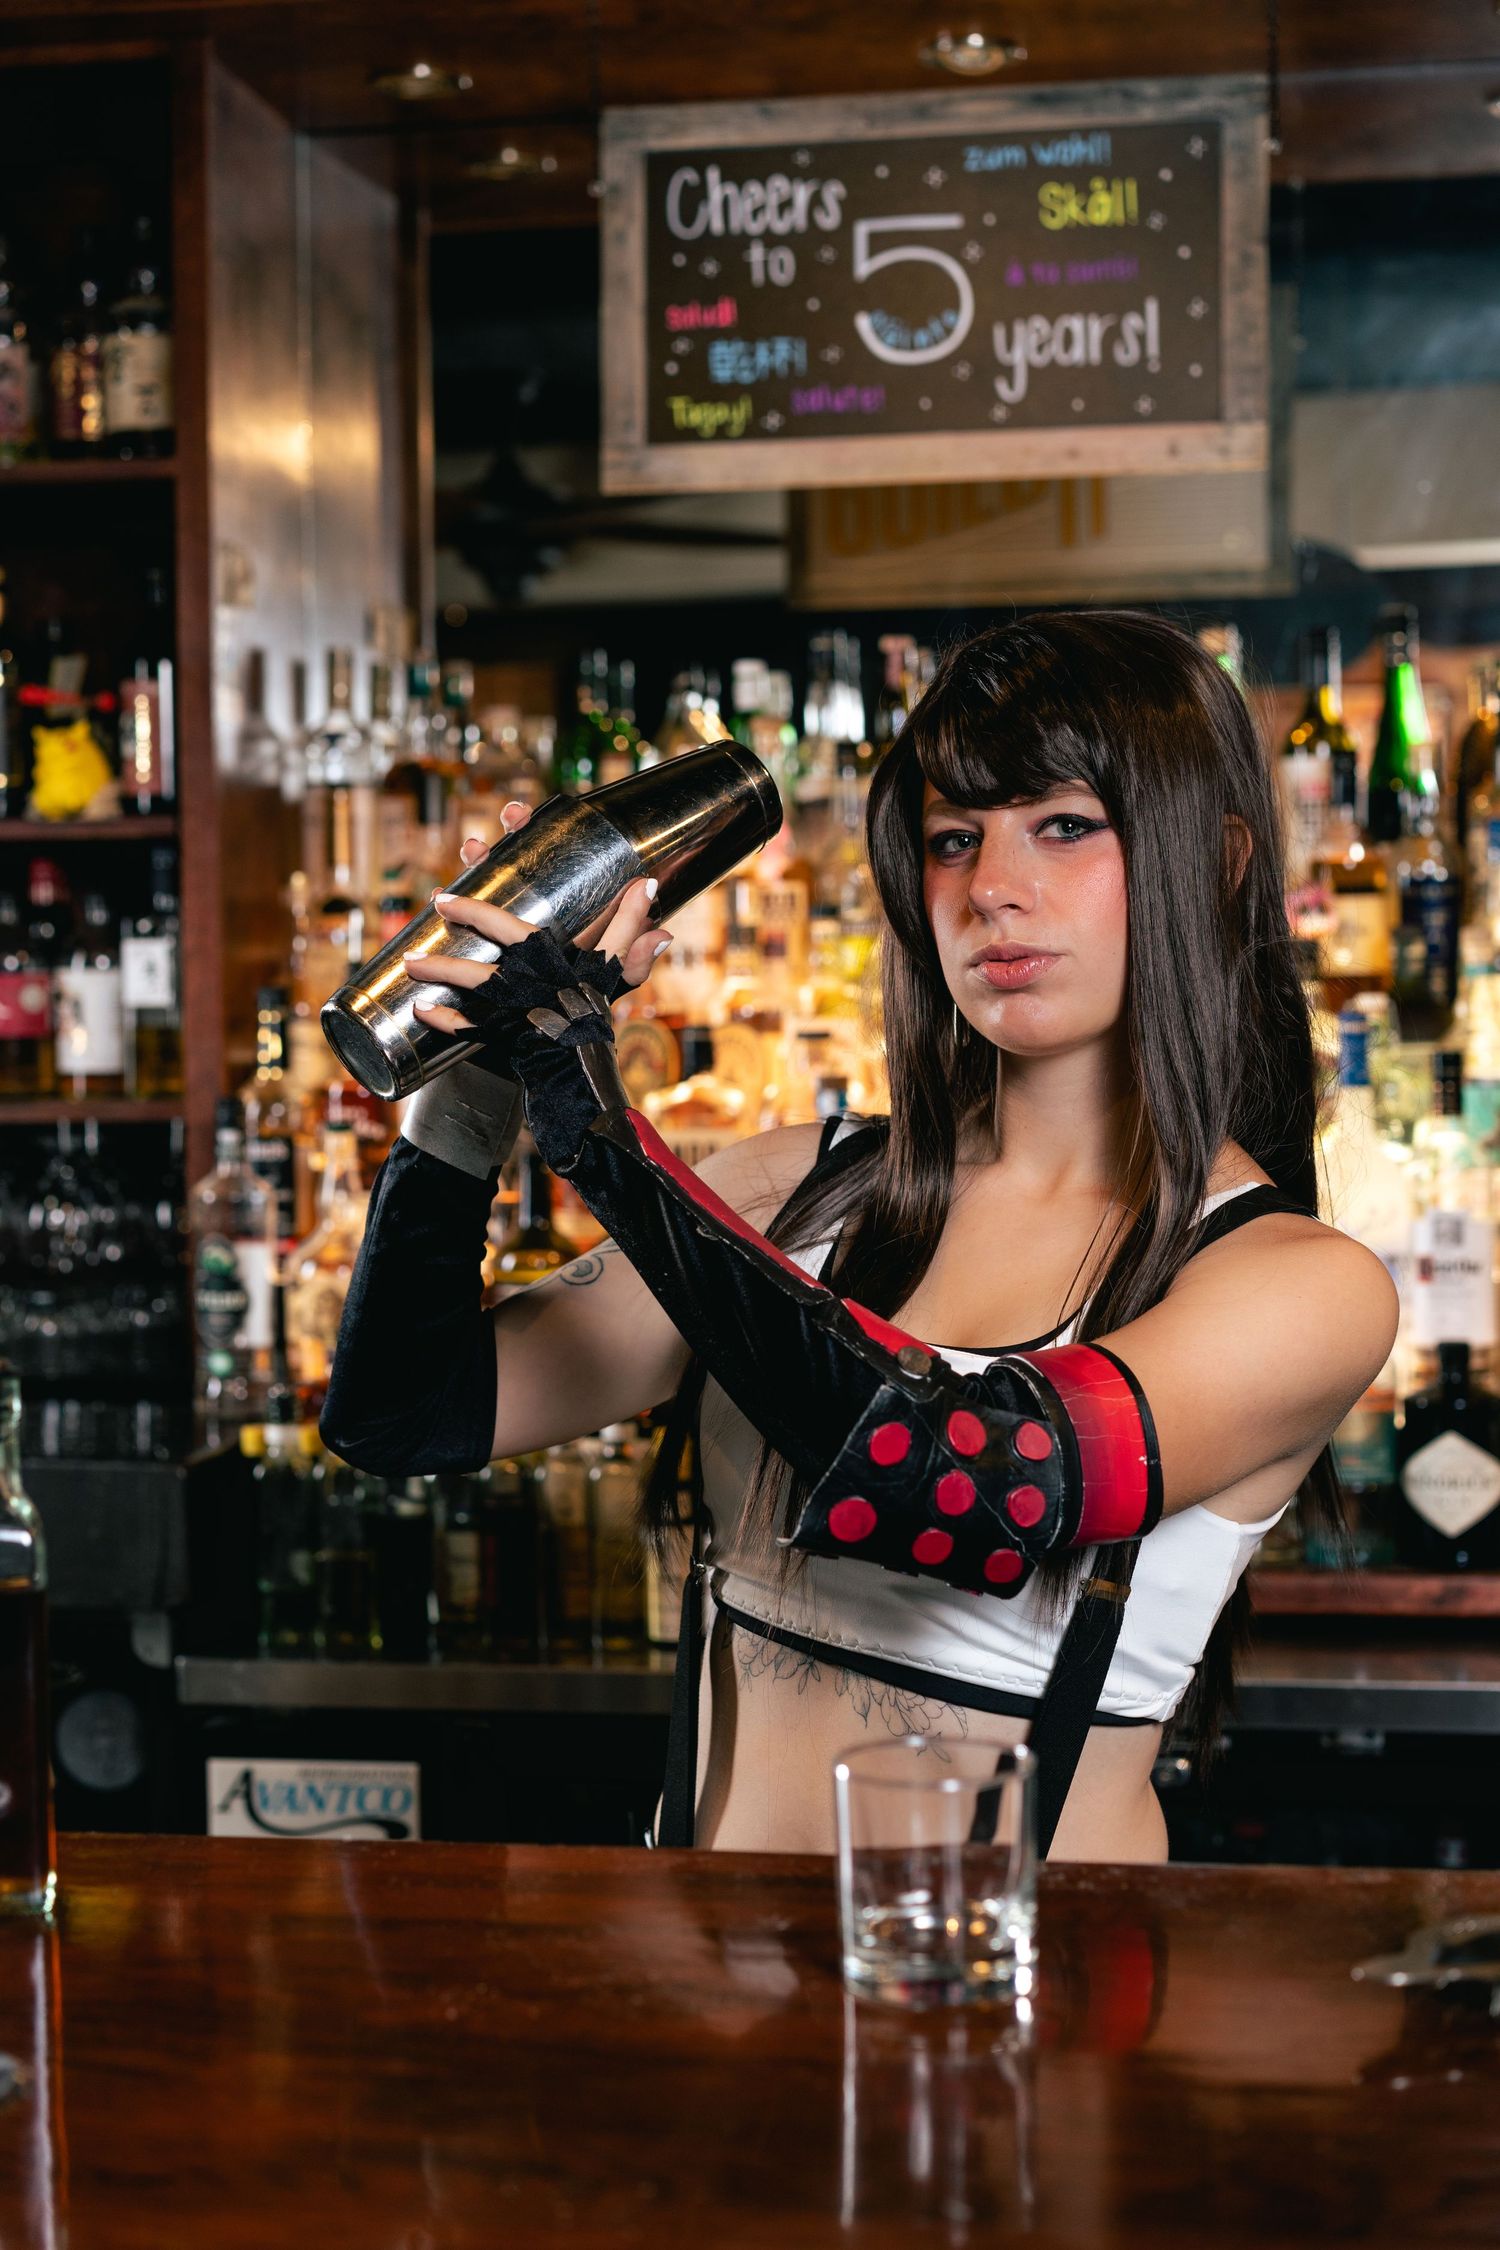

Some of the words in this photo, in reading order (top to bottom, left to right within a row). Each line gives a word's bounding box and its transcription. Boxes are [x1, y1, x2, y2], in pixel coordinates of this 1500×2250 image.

[666, 164, 847, 240] Cheers
[1038, 176, 1139, 231] Skål!
[743, 238, 796, 288] to
[853, 213, 975, 365] 5
[992, 294, 1162, 404] years!
[218, 1767, 412, 1837] AVANTCO
